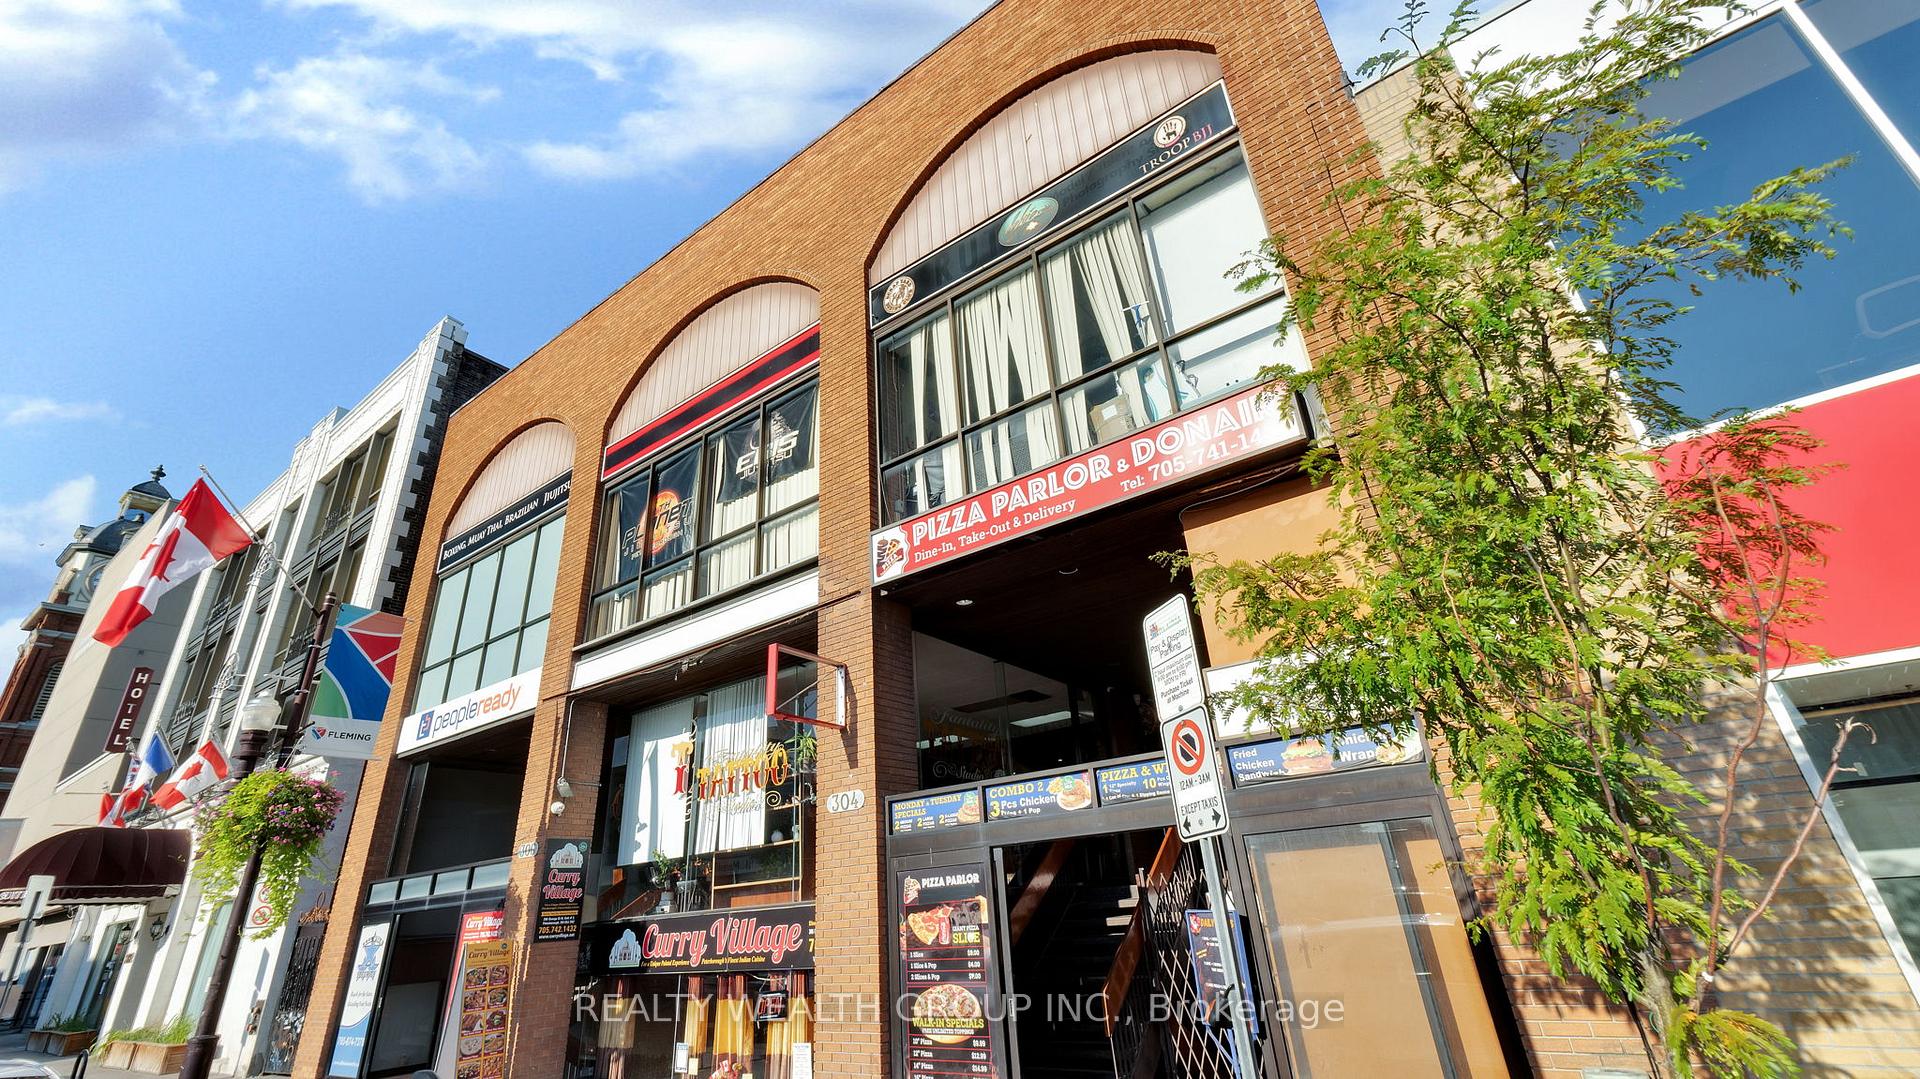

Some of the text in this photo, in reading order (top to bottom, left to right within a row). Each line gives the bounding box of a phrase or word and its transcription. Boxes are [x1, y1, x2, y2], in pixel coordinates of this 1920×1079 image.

[1139, 123, 1214, 174] TROOP BJJ
[913, 392, 1263, 546] PIZZA PARLOR & DONAI
[1120, 475, 1145, 492] Tel:
[467, 531, 487, 546] MUAY
[504, 498, 539, 525] BRAZILIAN
[914, 498, 1076, 564] Dine-In, Take-Out & Delivery
[1166, 627, 1188, 643] Display
[1160, 642, 1182, 659] Parking
[1160, 677, 1194, 699] Purchase Ticket
[1171, 689, 1190, 702] Machine
[114, 672, 150, 747] HOTEL
[432, 683, 521, 737] peopleready
[327, 730, 372, 743] FLEMING
[1233, 748, 1258, 759] Fried
[1235, 759, 1275, 770] Chicken
[697, 748, 790, 801] TATTOO
[1101, 766, 1151, 782] PIZZA &
[1179, 777, 1194, 791] 12AM
[1198, 771, 1211, 784] 3AM
[989, 781, 1043, 798] COMBO 2
[1143, 778, 1157, 789] 10
[830, 792, 861, 812] 304
[895, 800, 925, 811] MONDAY
[929, 794, 961, 805] TUESDAY
[990, 801, 1000, 817] 3
[1001, 795, 1056, 809] Pcs Chicken
[1180, 796, 1219, 816] EXCEPT TAXIS
[895, 808, 927, 819] SPECIALS
[939, 814, 945, 824] 2
[895, 820, 900, 831] 2
[917, 818, 923, 828] 2
[548, 869, 580, 886] Curry
[921, 873, 980, 889] PIZZA PARLOR
[543, 885, 582, 902] Village
[465, 917, 483, 930] Curry
[538, 925, 577, 934] 705.742.1432
[642, 923, 707, 968] Curry
[710, 917, 803, 964] Village
[952, 932, 980, 944] SLICE
[468, 948, 510, 959] Curry Village
[928, 962, 937, 970] Pop
[757, 996, 782, 1015] OPEN
[912, 1017, 984, 1029] WALK-IN SPECIALS
[920, 1050, 933, 1058] Pizza
[921, 1062, 934, 1070] Pizza
